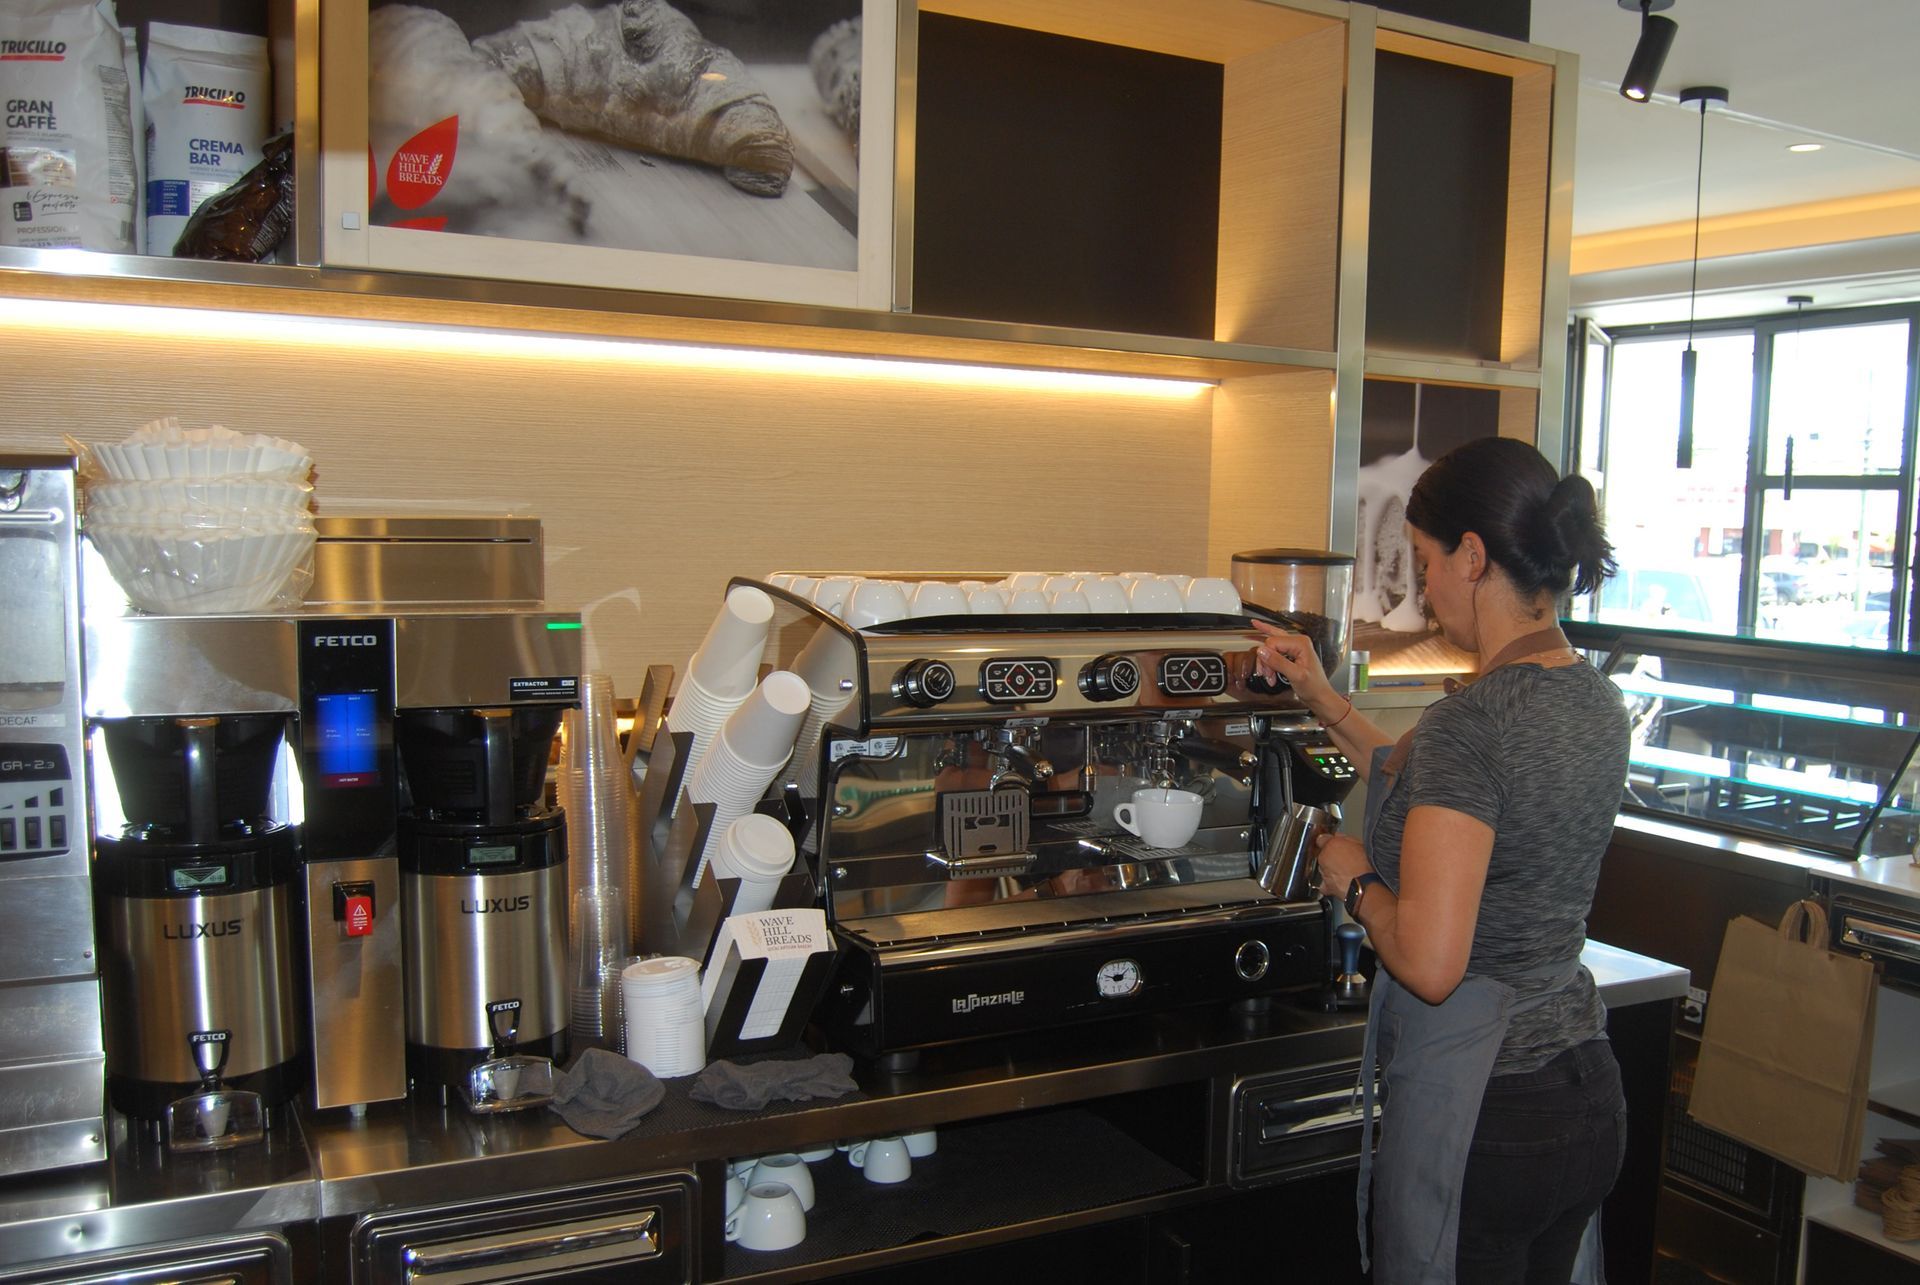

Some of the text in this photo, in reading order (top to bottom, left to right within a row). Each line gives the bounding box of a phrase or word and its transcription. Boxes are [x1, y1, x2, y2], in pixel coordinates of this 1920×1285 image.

[0, 40, 67, 54] TRUCILLO
[185, 85, 246, 103] TRUCILLO
[6, 99, 53, 114] GRAN
[189, 138, 245, 156] CREMA
[189, 152, 221, 166] BAR
[399, 152, 429, 165] WAVE
[399, 162, 425, 174] HILL
[399, 172, 443, 185] BREADS
[314, 635, 377, 647] FETCO
[0, 716, 38, 726] DECAF
[461, 895, 530, 914] LUXUS
[760, 916, 794, 927] WAVE
[163, 919, 242, 940] LUXUS
[763, 926, 791, 936] HILL
[765, 935, 812, 946] BREADS
[492, 1001, 520, 1012] FETCO
[193, 1033, 226, 1042] FETCO
